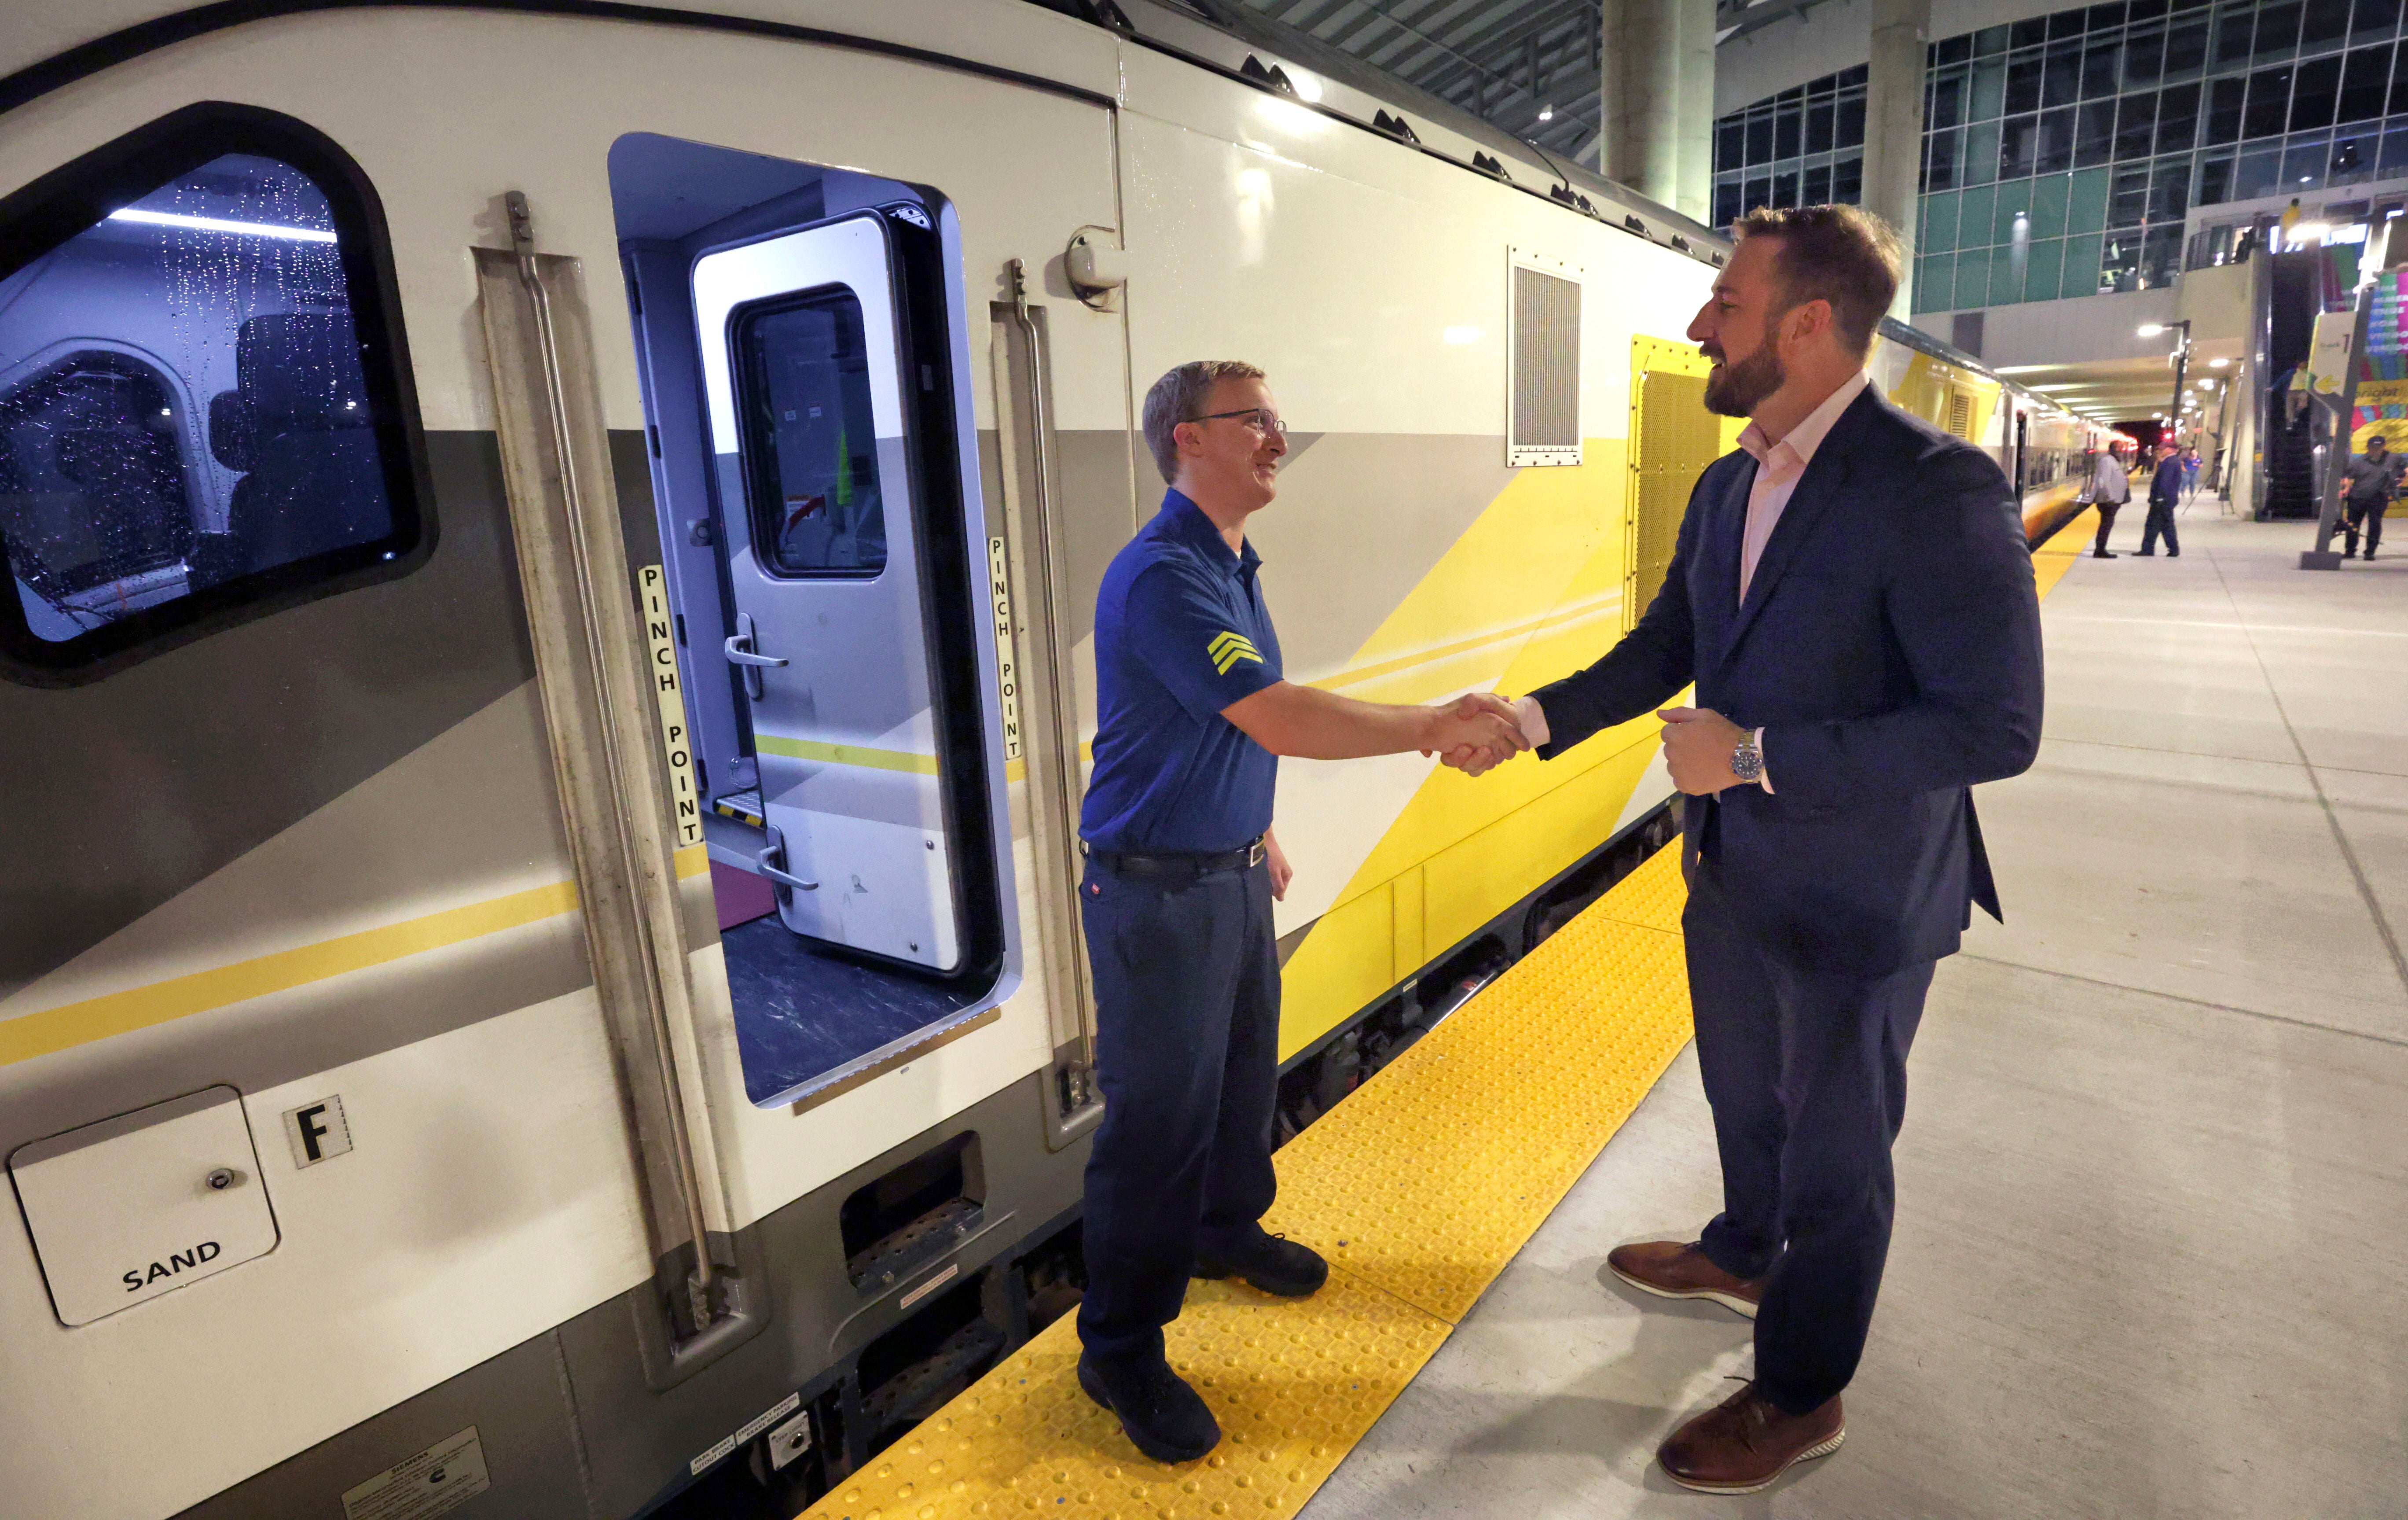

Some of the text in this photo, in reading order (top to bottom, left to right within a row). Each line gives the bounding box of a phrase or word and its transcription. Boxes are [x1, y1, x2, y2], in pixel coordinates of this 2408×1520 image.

[2342, 333, 2350, 353] 1
[993, 540, 1017, 755] PINCH POINT
[645, 569, 696, 840] PINCH POINT
[296, 1104, 327, 1162] F
[123, 1241, 221, 1292] SAND
[738, 1395, 797, 1436] EMERGENCY PARKING
[747, 1405, 791, 1437] BRAKE RELEASE
[391, 1452, 429, 1475] SIEMENS
[693, 1443, 734, 1472] CUTOUT COCK
[694, 1439, 730, 1465] PARK BRAKE
